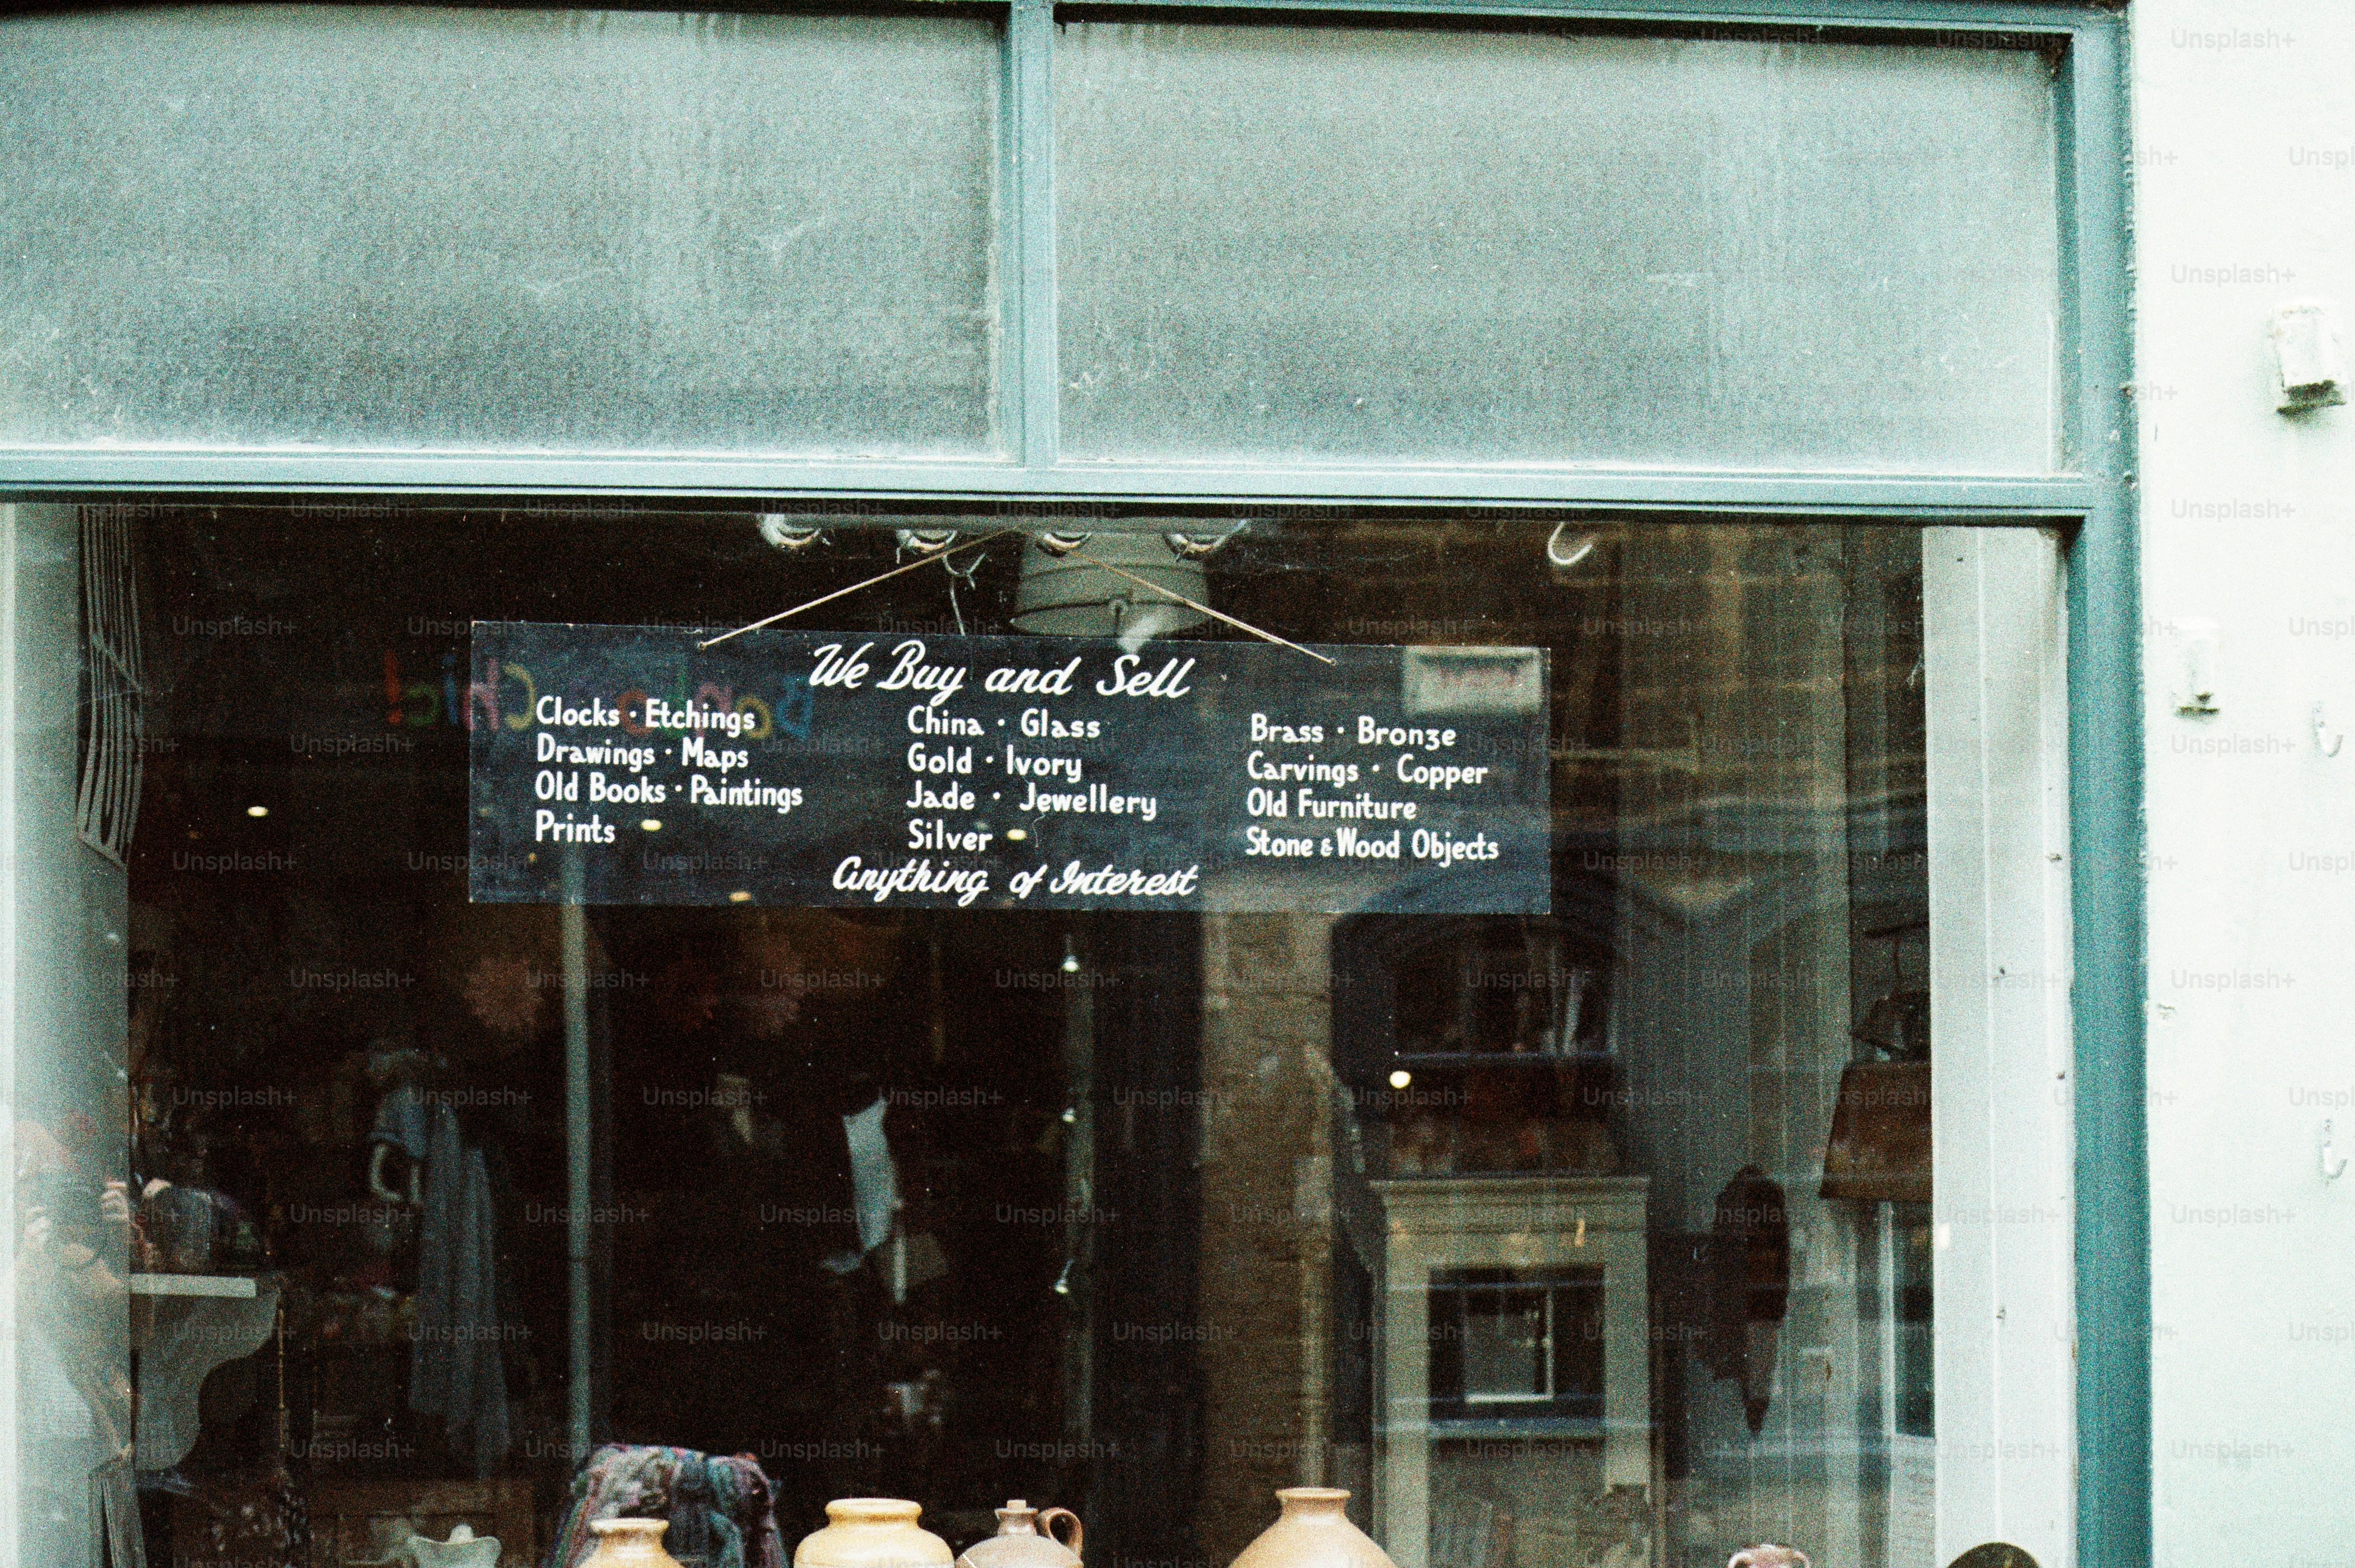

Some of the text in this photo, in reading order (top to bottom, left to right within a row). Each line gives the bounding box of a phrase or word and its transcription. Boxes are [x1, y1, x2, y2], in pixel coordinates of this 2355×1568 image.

[809, 640, 1195, 707] We Buy and Sell
[536, 695, 755, 738] Clocks Etchings
[907, 705, 1100, 738] China Glass
[1251, 713, 1324, 743] Brass
[1358, 716, 1456, 751] Bronze
[537, 732, 655, 773] Drawings
[682, 736, 748, 774] Maps
[907, 743, 1082, 783] Gold Ivory
[1247, 750, 1488, 790] Carvings Copper
[535, 770, 803, 814] Old Books Paintings
[906, 780, 1157, 821] Jade Jewellery
[1246, 787, 1417, 820] Old Furniture
[536, 810, 615, 843] Prints
[908, 819, 993, 851] Silver
[1245, 825, 1314, 857] Stone
[1335, 827, 1400, 859] Wood
[1411, 829, 1499, 868] Objects
[832, 856, 1198, 907] Anything of Interest
